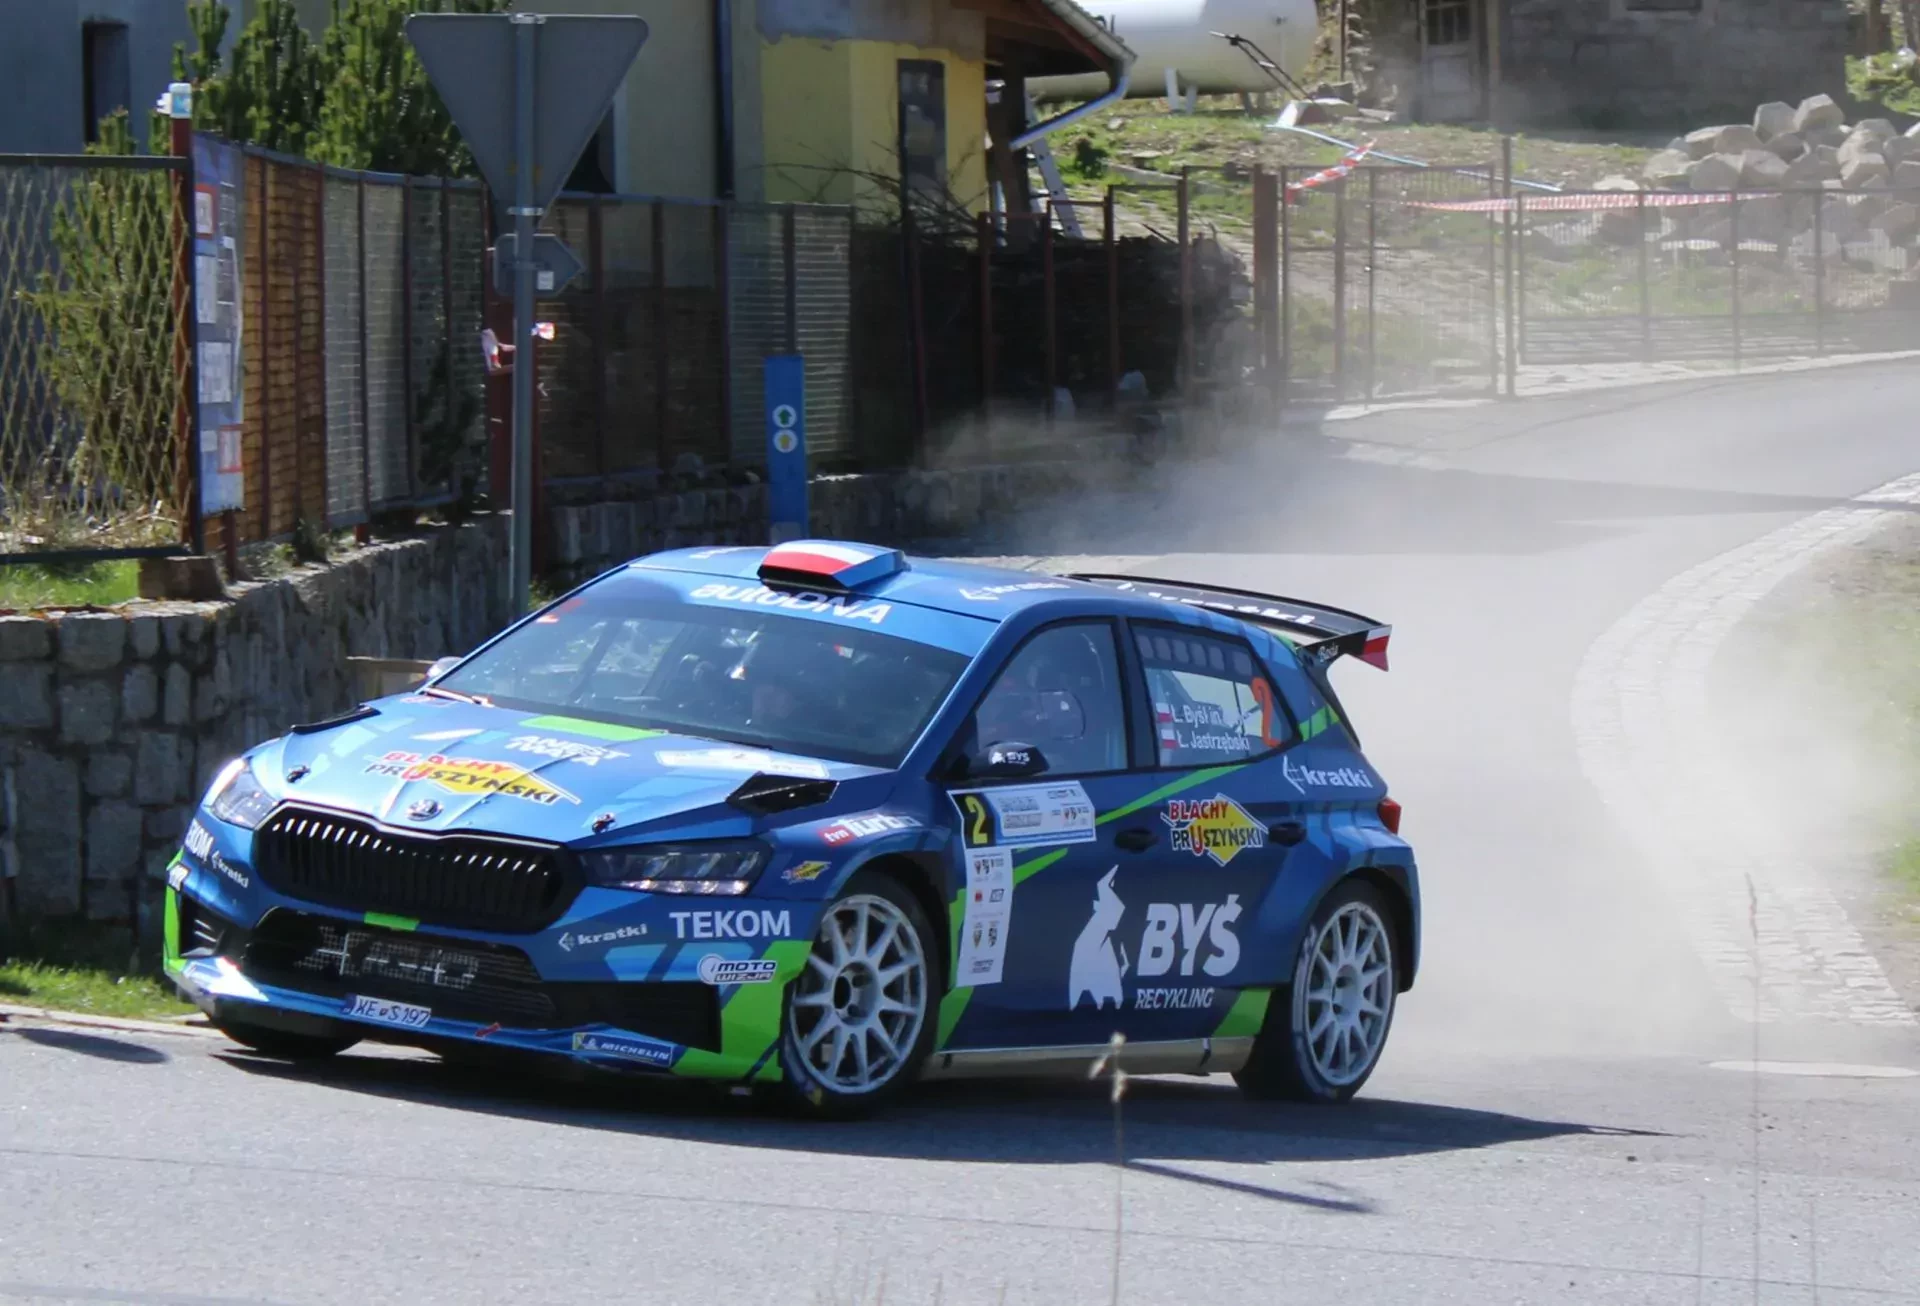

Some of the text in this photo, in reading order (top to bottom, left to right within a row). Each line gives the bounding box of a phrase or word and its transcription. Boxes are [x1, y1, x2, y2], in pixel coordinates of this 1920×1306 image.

[384, 751, 511, 774] BLACHY
[1300, 765, 1374, 789] kratki
[965, 795, 988, 844] 2
[1170, 800, 1229, 820] BLACHY
[823, 828, 850, 843] tvn
[1171, 822, 1262, 854] PRUSZYŃSKI
[577, 923, 648, 945] kratki
[668, 910, 791, 939] TEKOM
[1137, 894, 1243, 977] BYŚ
[1134, 987, 1216, 1010] RECYKLING
[600, 1042, 672, 1060] MICHELIN
